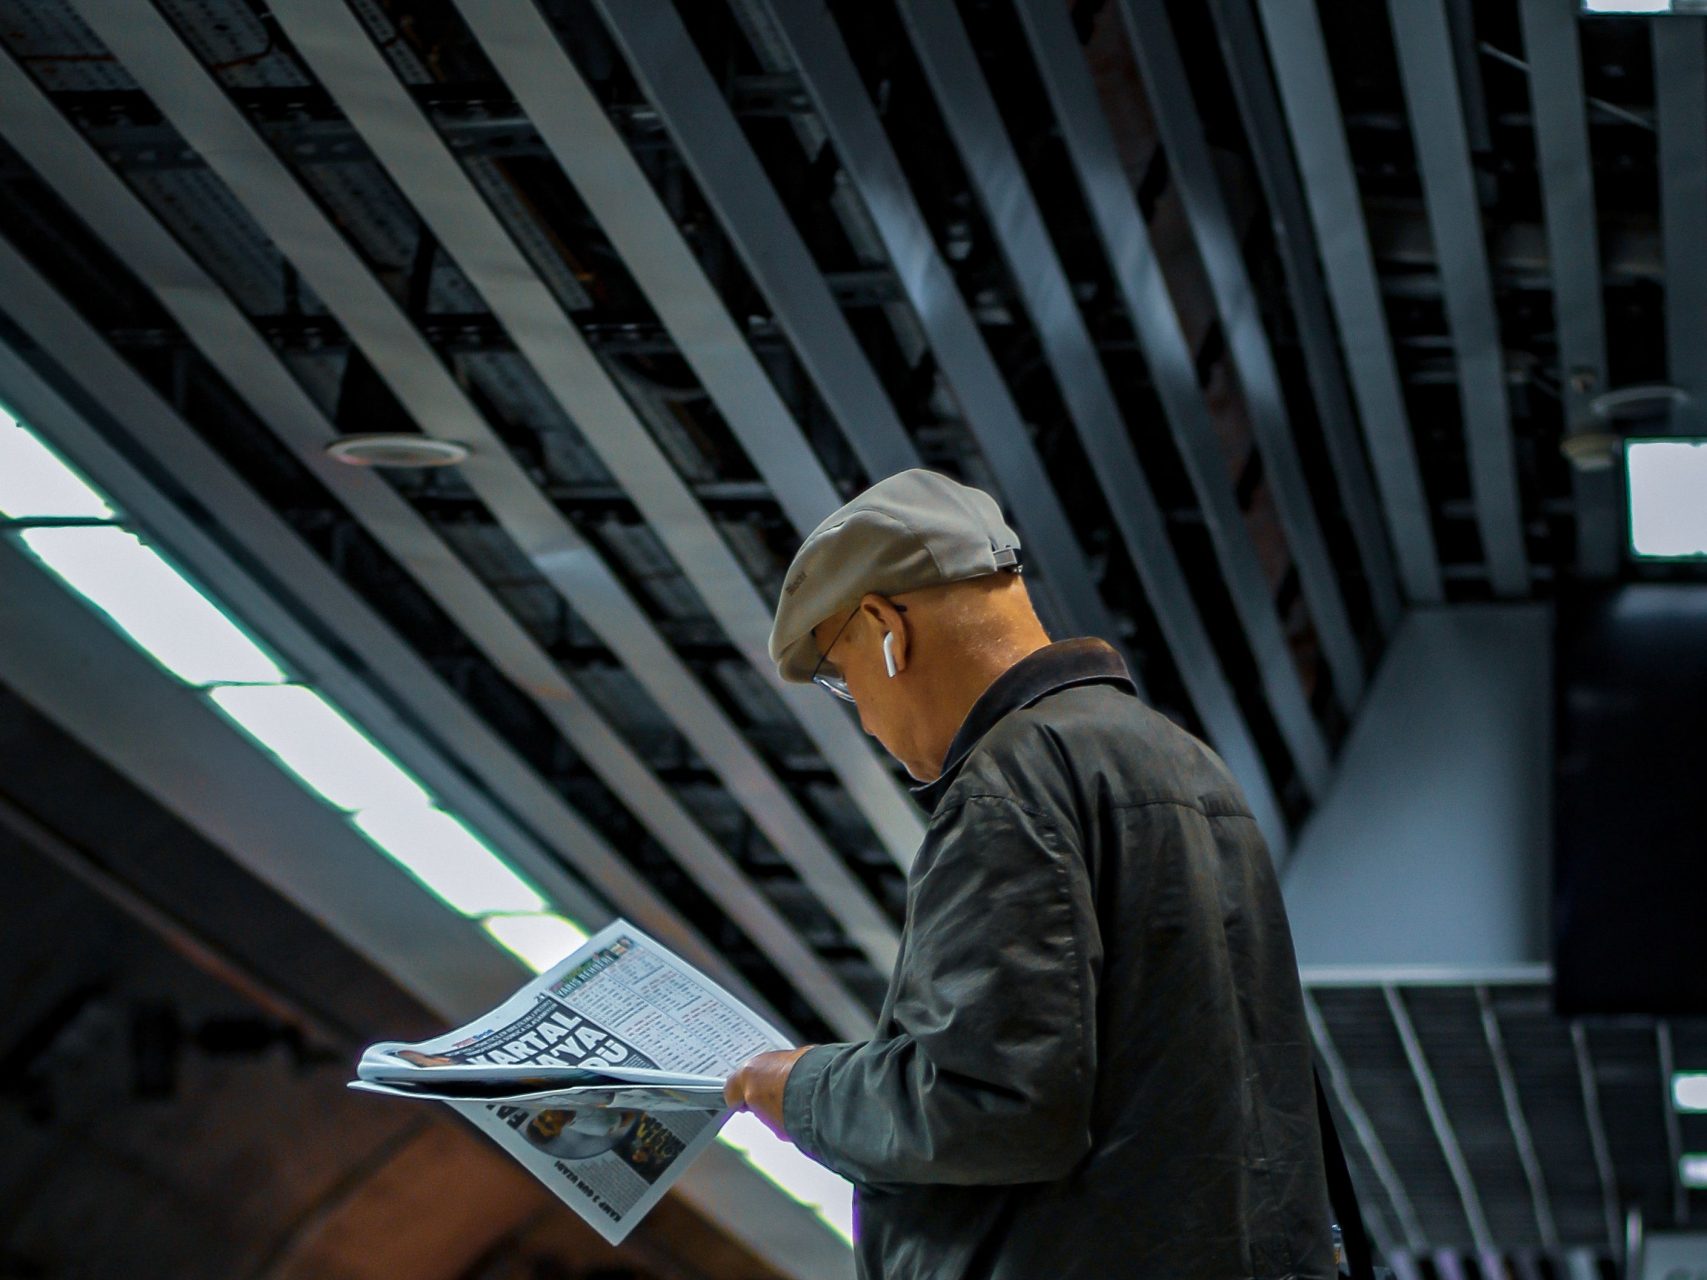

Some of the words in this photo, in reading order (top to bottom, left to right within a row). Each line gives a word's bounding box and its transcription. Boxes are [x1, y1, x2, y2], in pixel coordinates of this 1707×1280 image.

[466, 1011, 583, 1065] KARTAL
[521, 1026, 608, 1067] A'YA
[486, 1104, 530, 1130] FA
